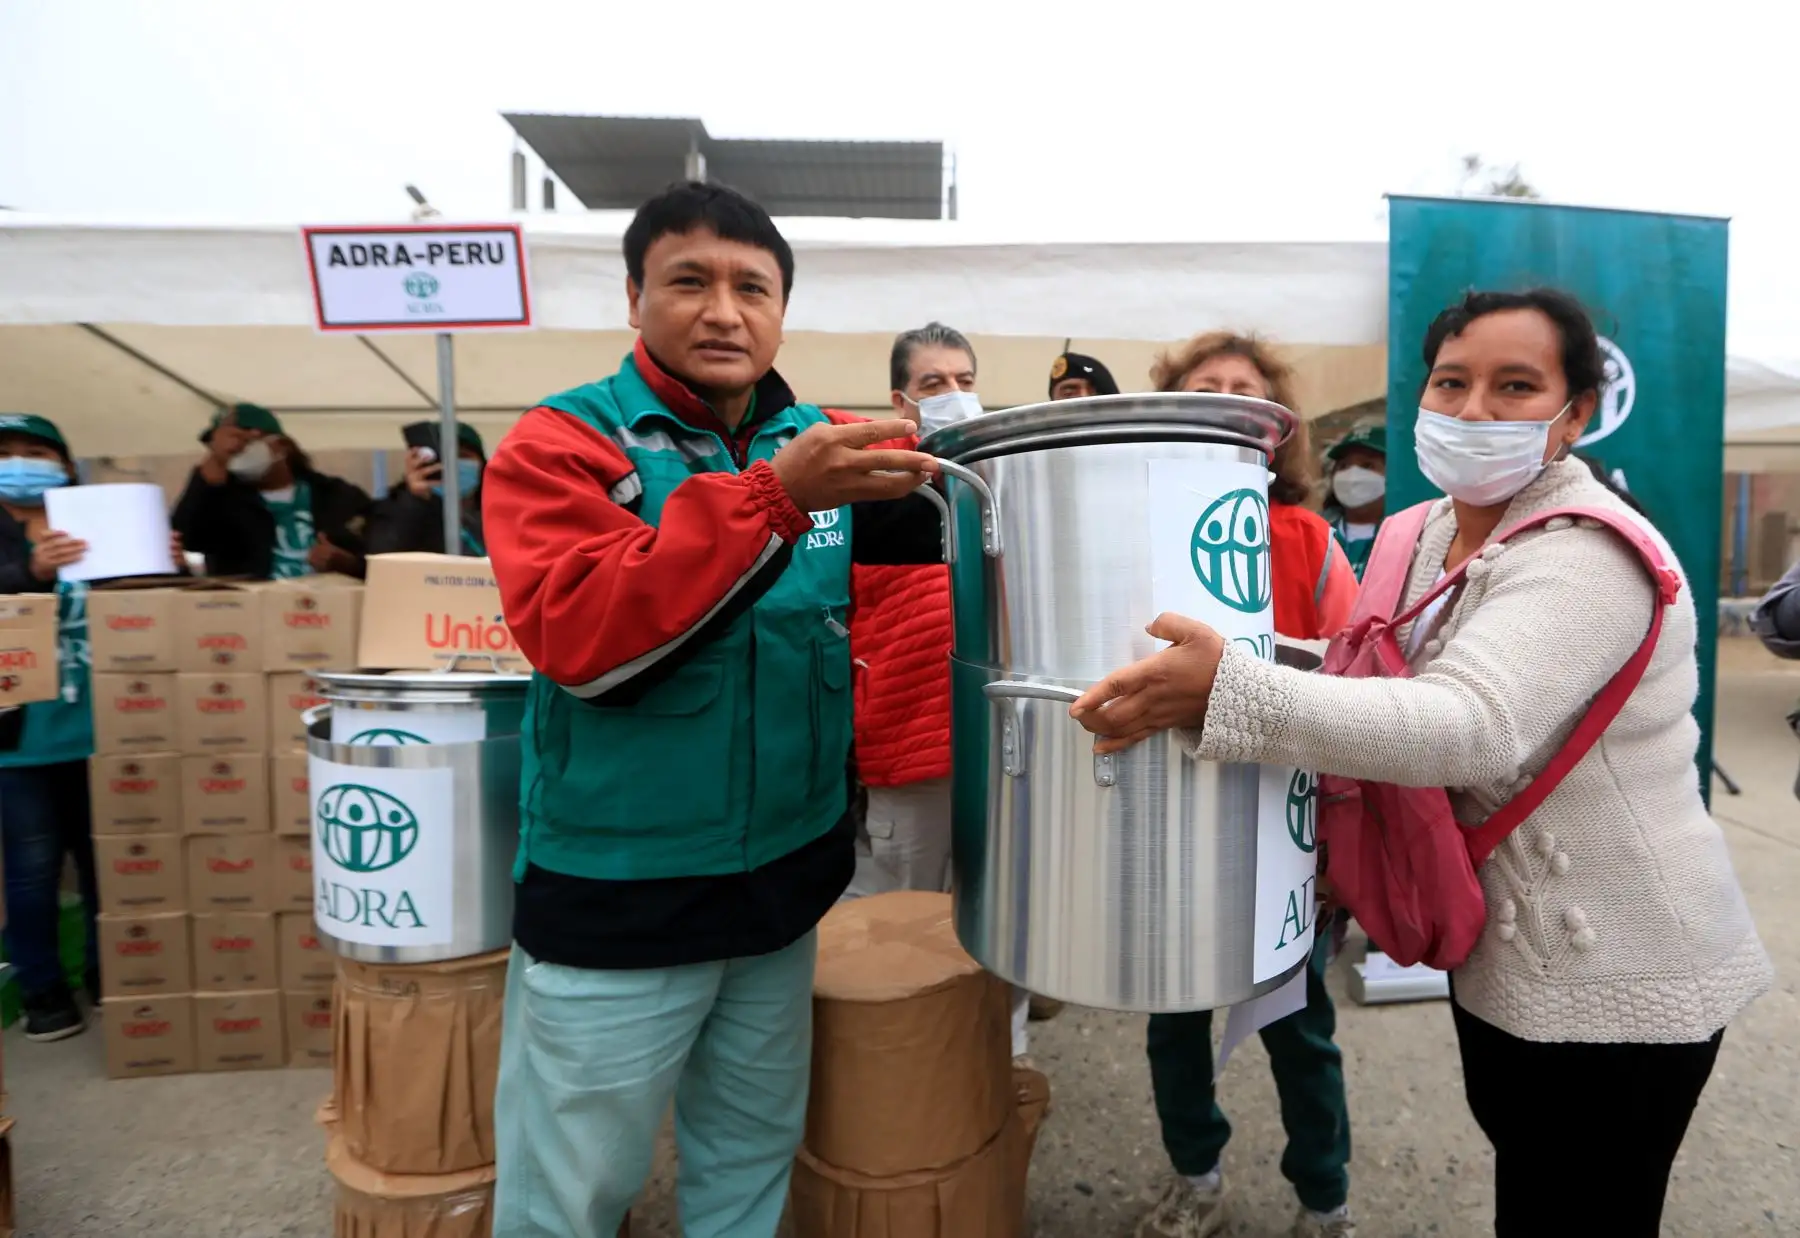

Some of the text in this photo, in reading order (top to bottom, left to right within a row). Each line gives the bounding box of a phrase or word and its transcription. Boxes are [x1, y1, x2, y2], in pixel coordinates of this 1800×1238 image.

[328, 241, 505, 268] ADRA-PERU
[805, 530, 846, 550] ADRA
[317, 877, 428, 929] ADRA
